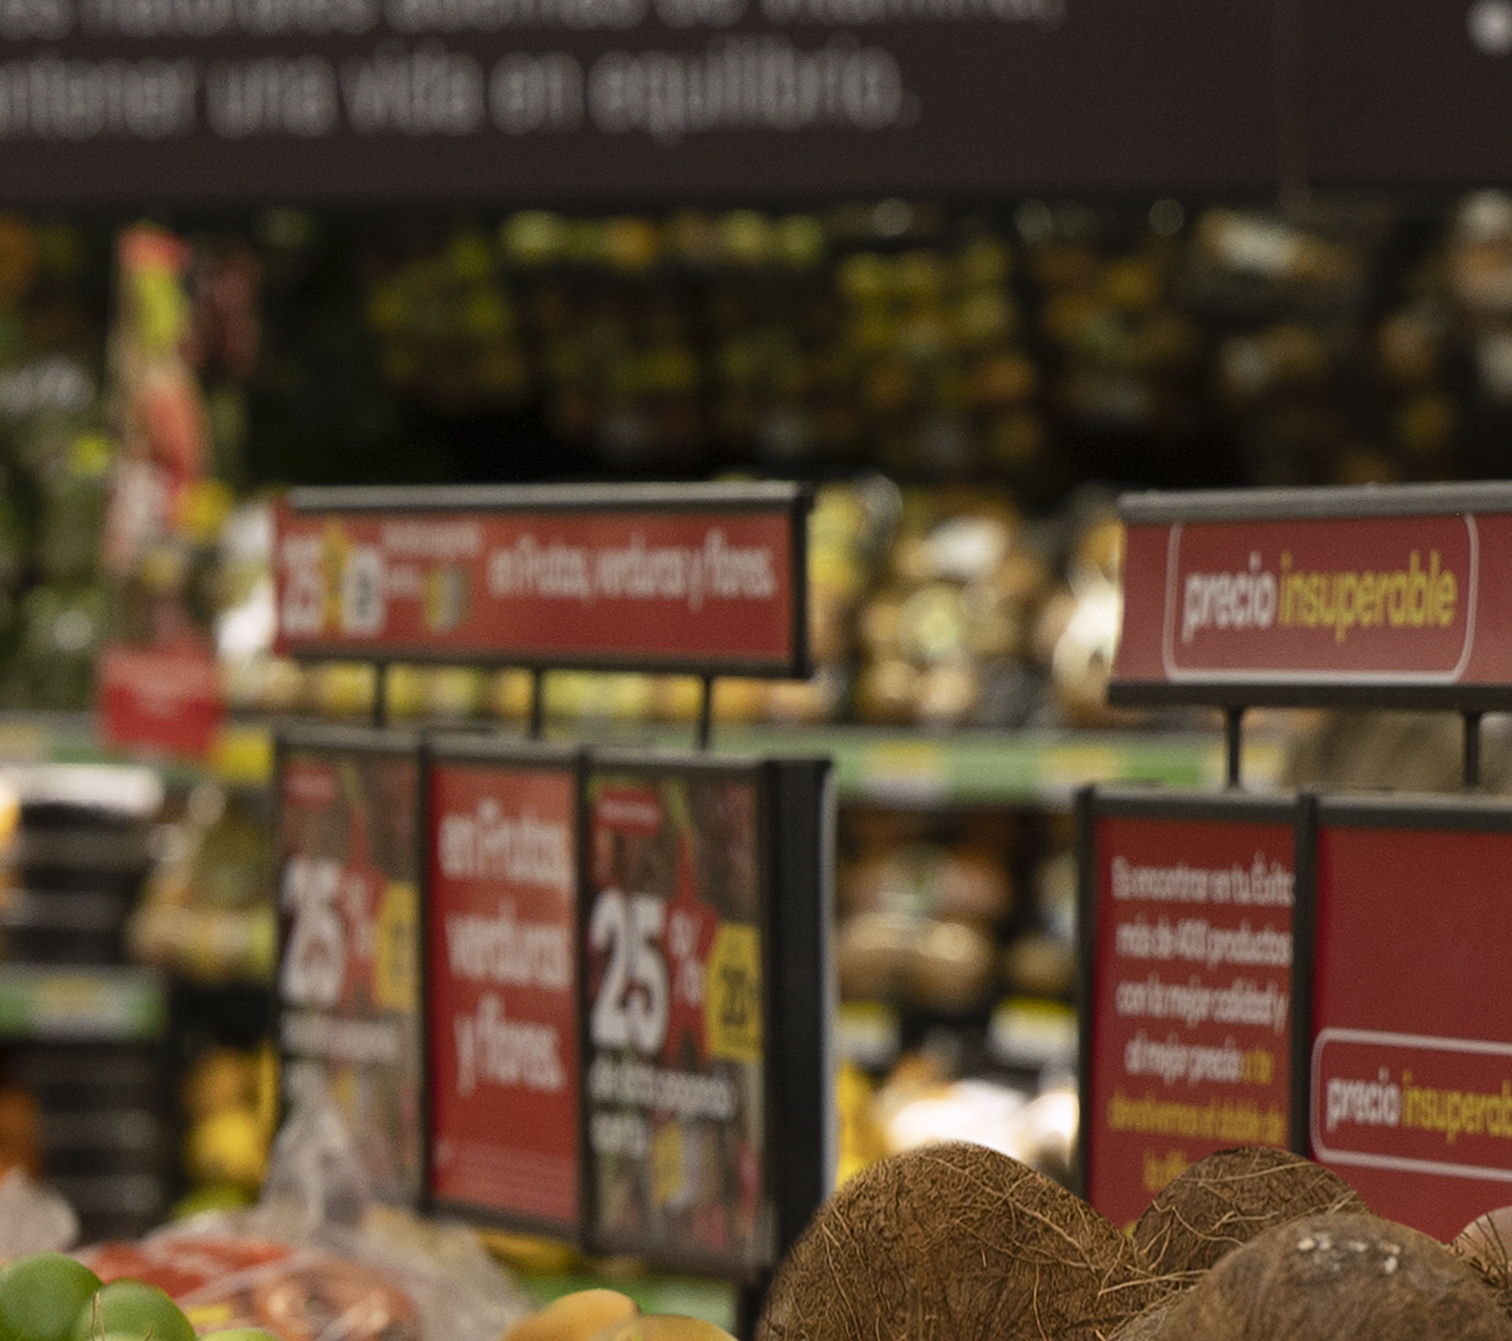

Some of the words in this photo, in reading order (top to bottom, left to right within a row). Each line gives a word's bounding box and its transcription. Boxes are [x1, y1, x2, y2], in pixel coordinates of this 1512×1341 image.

[208, 60, 334, 134] una
[344, 46, 481, 132] vida
[491, 56, 580, 131] en
[597, 538, 684, 598] verduras
[685, 548, 704, 609] y
[1184, 552, 1277, 641] precio
[1279, 551, 1456, 641] insuperable
[439, 812, 481, 878] en
[448, 902, 570, 991] verduras
[1153, 915, 1173, 959] de
[1208, 918, 1293, 971] productos
[1115, 979, 1146, 1017] con
[1165, 974, 1211, 1028] mejor
[1213, 978, 1273, 1026] calidad
[1274, 993, 1289, 1035] y
[454, 1012, 477, 1094] y
[1147, 1031, 1187, 1084] mejor
[1188, 1036, 1242, 1086] precio
[1327, 1068, 1401, 1129] precio
